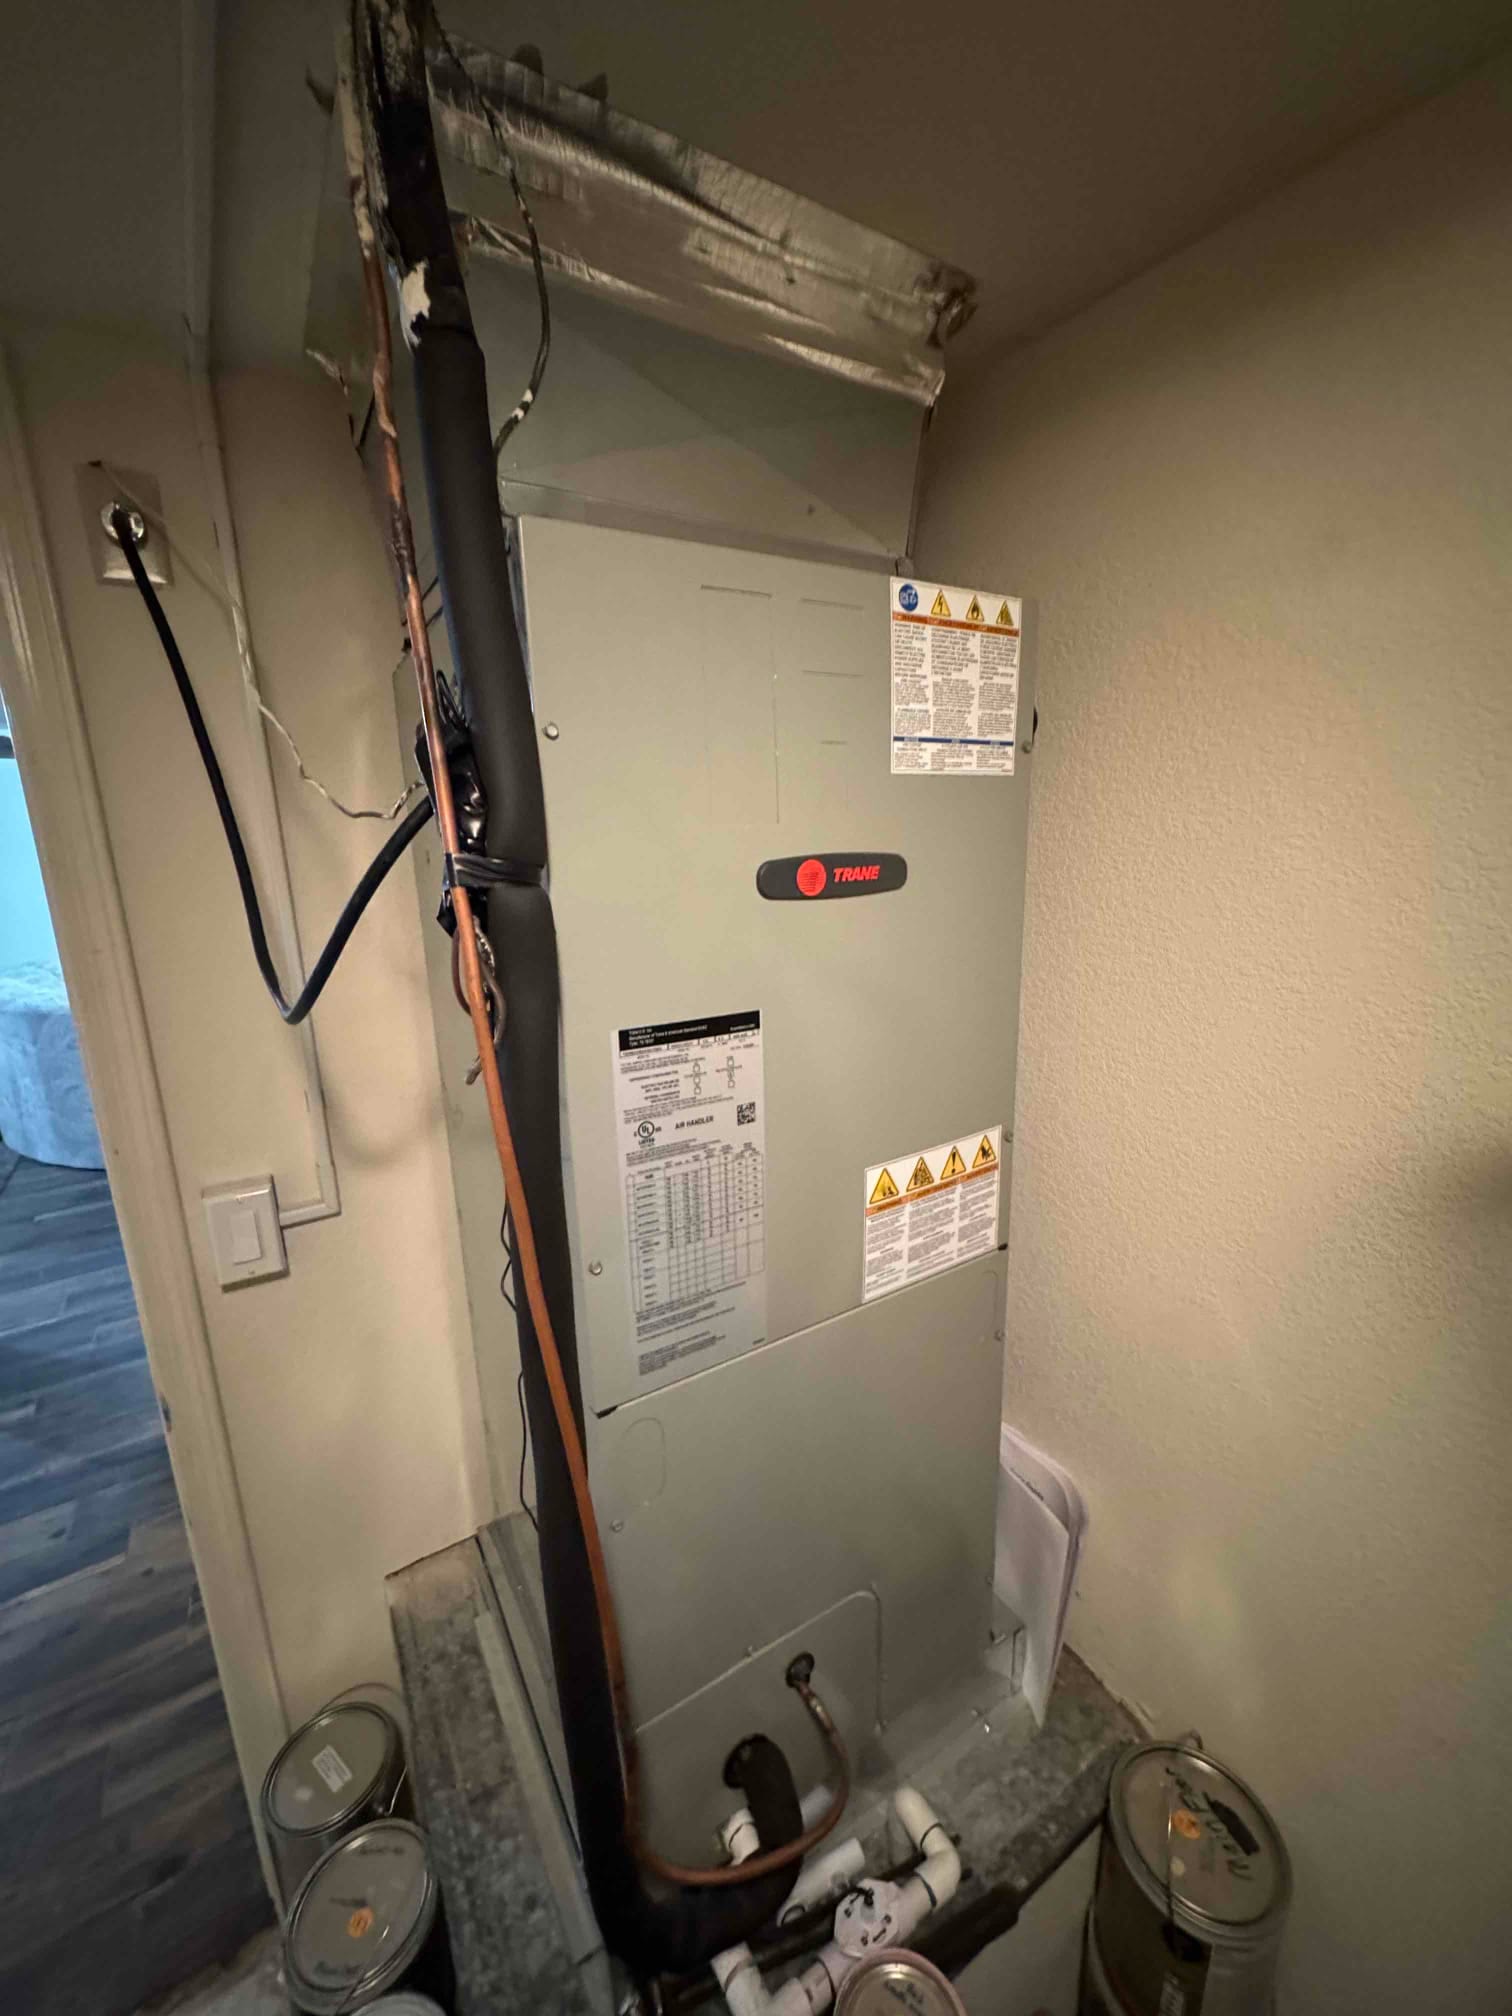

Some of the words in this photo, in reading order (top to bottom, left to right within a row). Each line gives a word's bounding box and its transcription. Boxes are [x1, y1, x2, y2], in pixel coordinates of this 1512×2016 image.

[833, 866, 880, 882] TRANE
[675, 1121, 685, 1130] AIR
[686, 1115, 714, 1127] HANDLER
